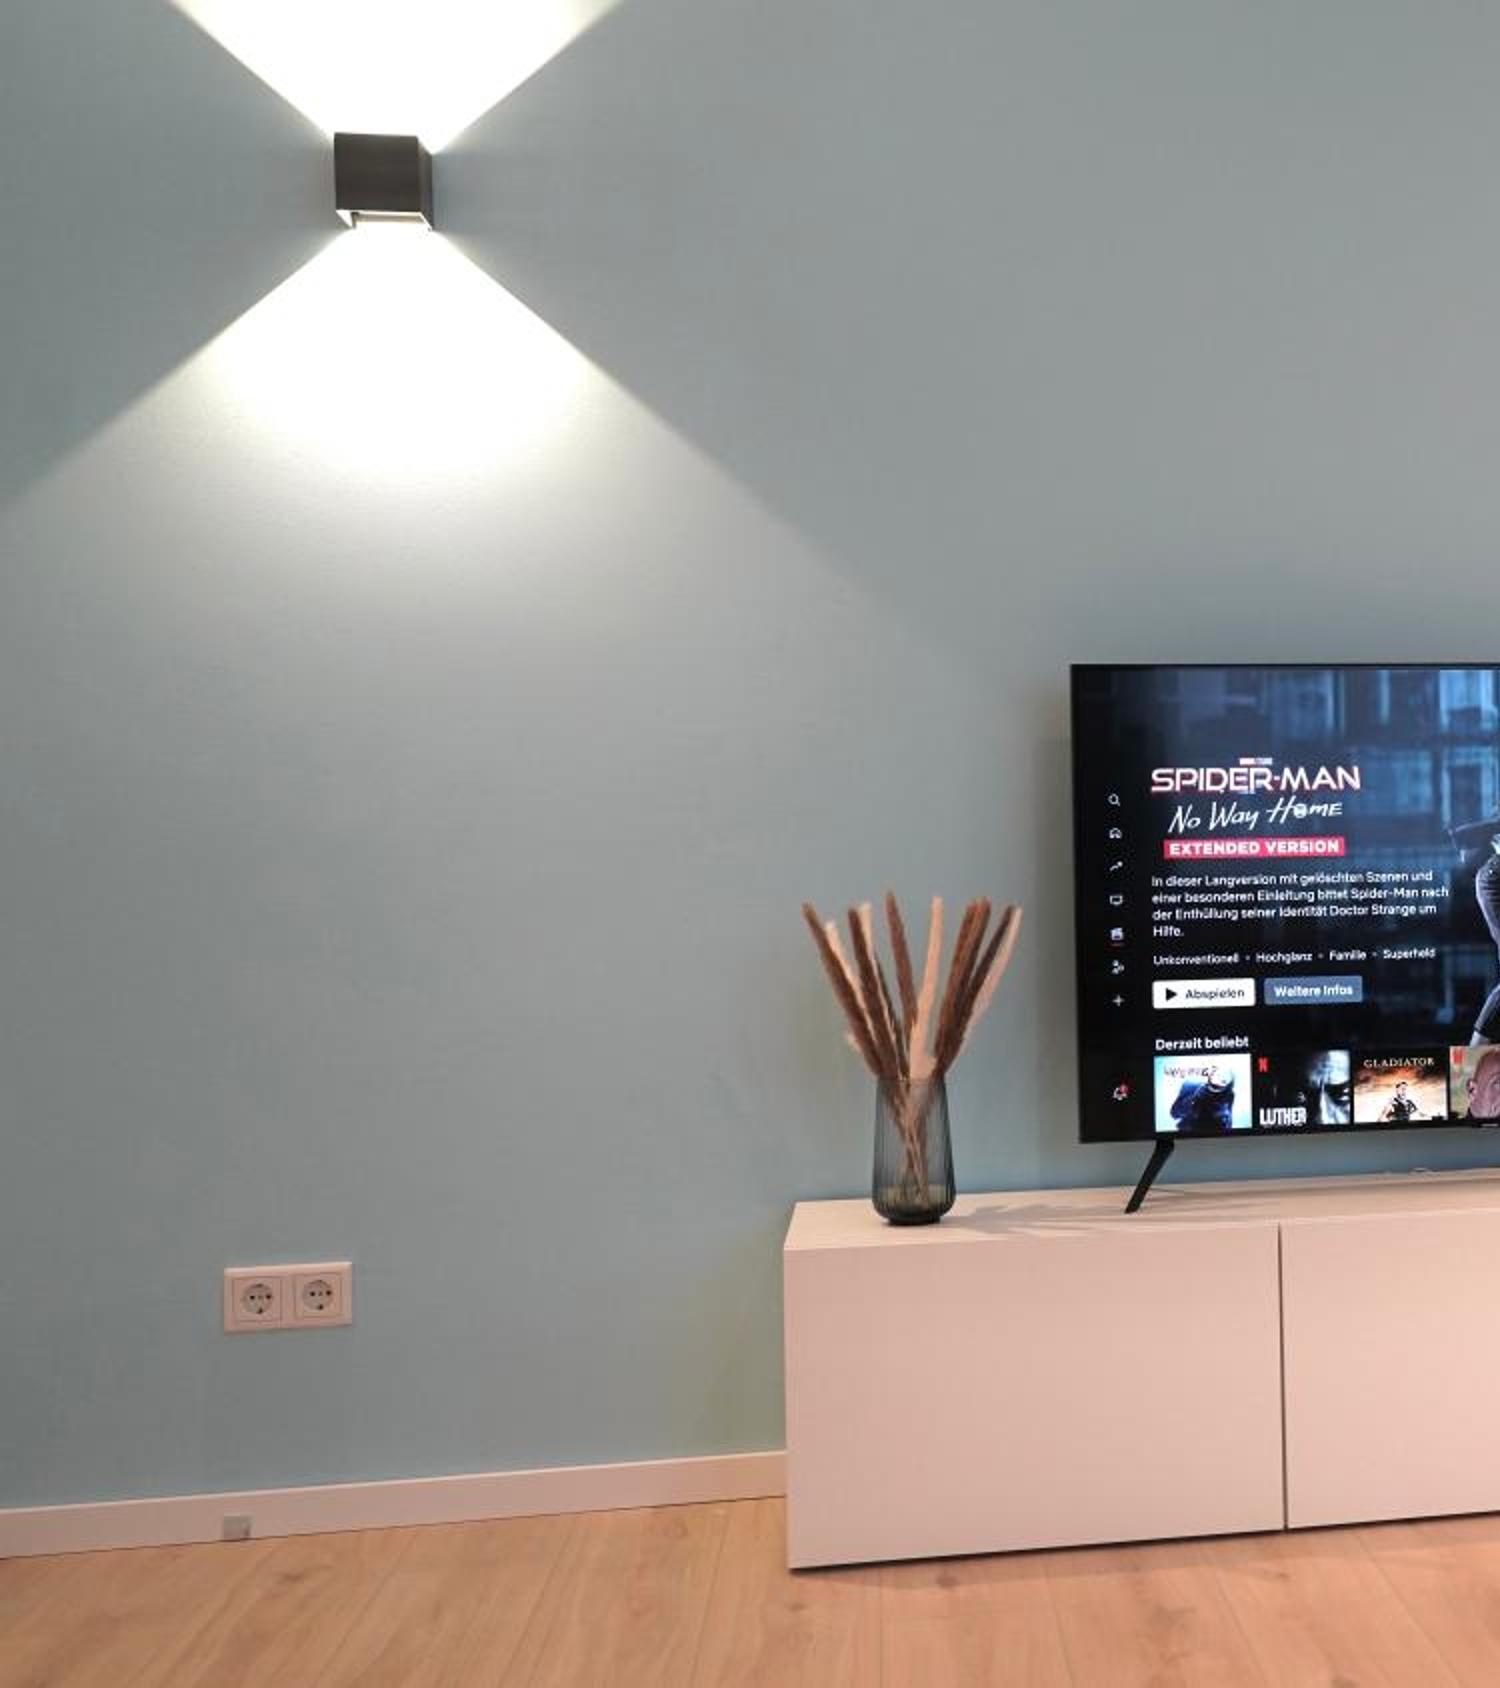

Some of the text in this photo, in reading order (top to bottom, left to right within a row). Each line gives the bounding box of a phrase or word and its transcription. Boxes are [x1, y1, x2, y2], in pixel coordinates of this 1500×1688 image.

[1151, 765, 1360, 794] SPIDER-MAN
[1168, 804, 1201, 834] No
[1209, 801, 1259, 831] Way
[1169, 839, 1339, 856] EXTENDED VERSION
[1151, 876, 1163, 887] In
[1165, 875, 1203, 888] dieser
[1205, 873, 1277, 889] Langversion
[1279, 873, 1299, 885] mit
[1366, 871, 1409, 883] Szenen
[1411, 869, 1434, 881] und
[1151, 891, 1182, 904] einer
[1184, 890, 1255, 904] besonderen
[1257, 889, 1315, 903] Einleitung
[1351, 887, 1419, 900] Spider-Man
[1421, 885, 1450, 897] nach
[1152, 909, 1173, 920] der
[1241, 906, 1277, 918] seiner
[1329, 905, 1369, 917] Doctor
[1371, 903, 1417, 917] Strange
[1419, 904, 1438, 916] um
[1153, 925, 1184, 937] Hilfe.
[1255, 950, 1313, 965] Hochglanz
[1328, 949, 1367, 961] Familie
[1383, 947, 1437, 961] Superheld
[1185, 987, 1245, 1000] Abspielen
[1273, 983, 1354, 997] Weitere Infos
[1155, 1034, 1249, 1051] Derzeit beliebt
[1363, 1057, 1435, 1069] GLADIATOR
[1259, 1107, 1307, 1127] LUTHER
